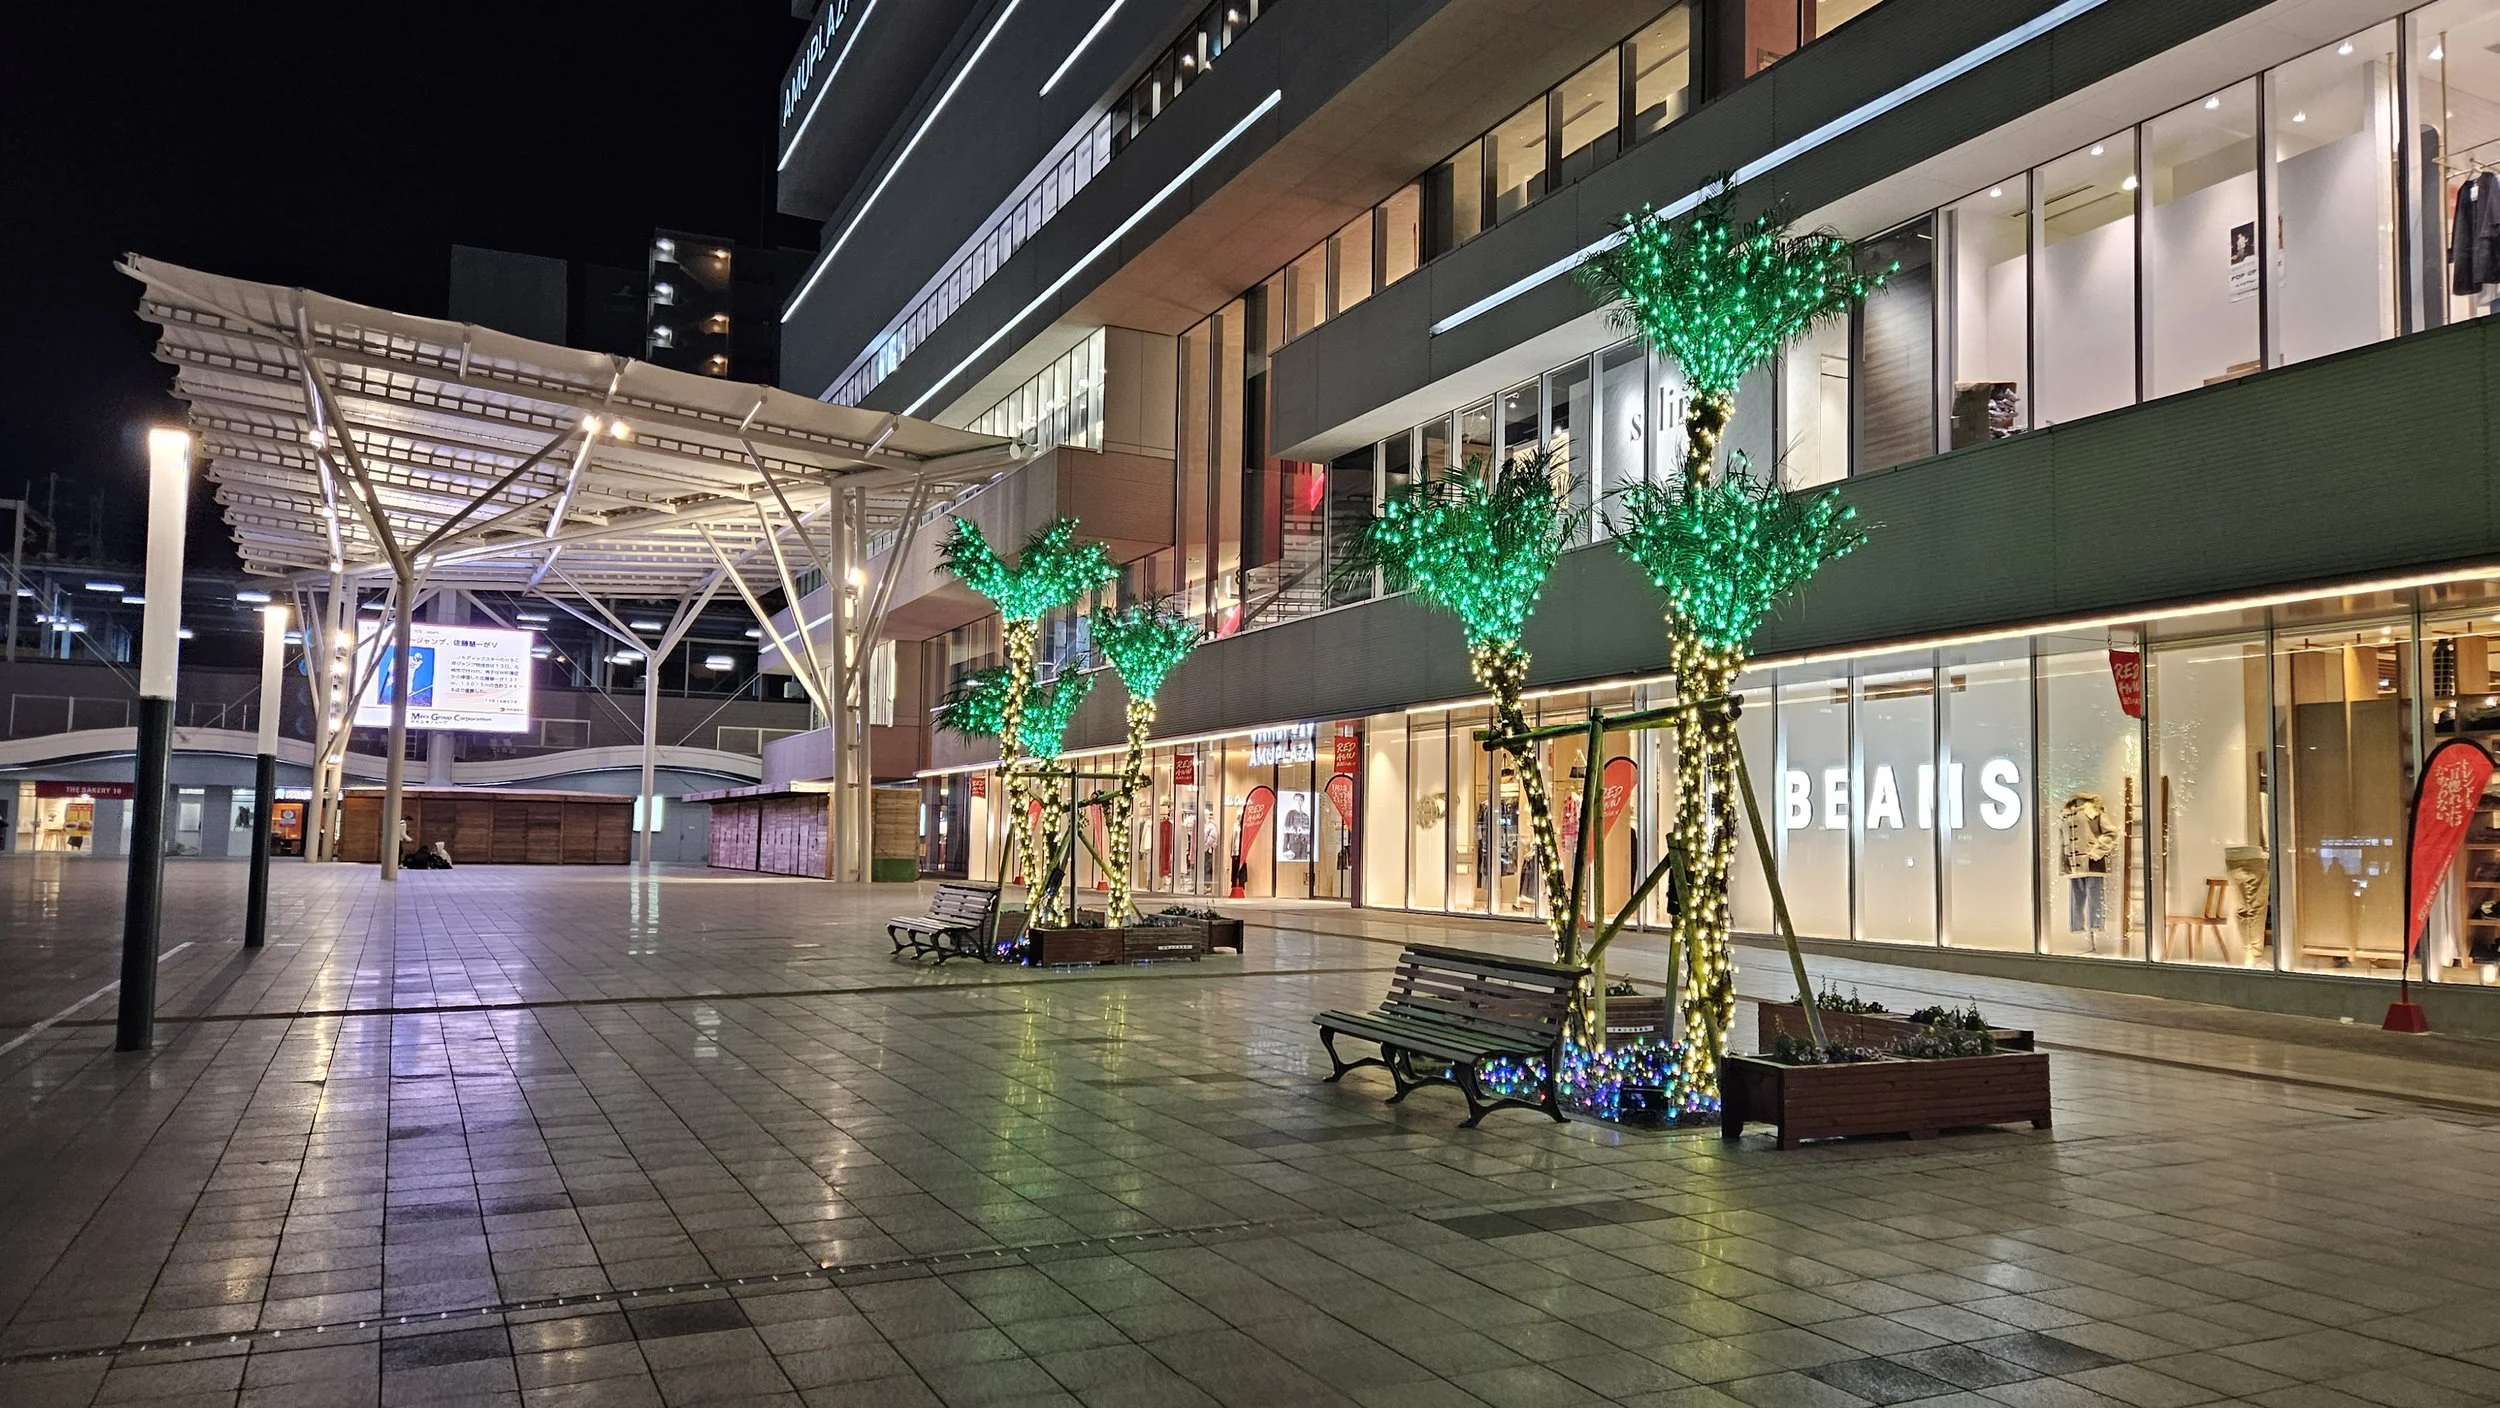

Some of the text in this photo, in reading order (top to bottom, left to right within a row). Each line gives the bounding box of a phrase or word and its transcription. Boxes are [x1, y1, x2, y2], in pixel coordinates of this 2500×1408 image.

[782, 0, 849, 128] AMUPLAZ
[1248, 743, 1315, 767] AMUPLAZA
[1336, 741, 1356, 753] RED
[1785, 758, 2022, 830] BEAMS
